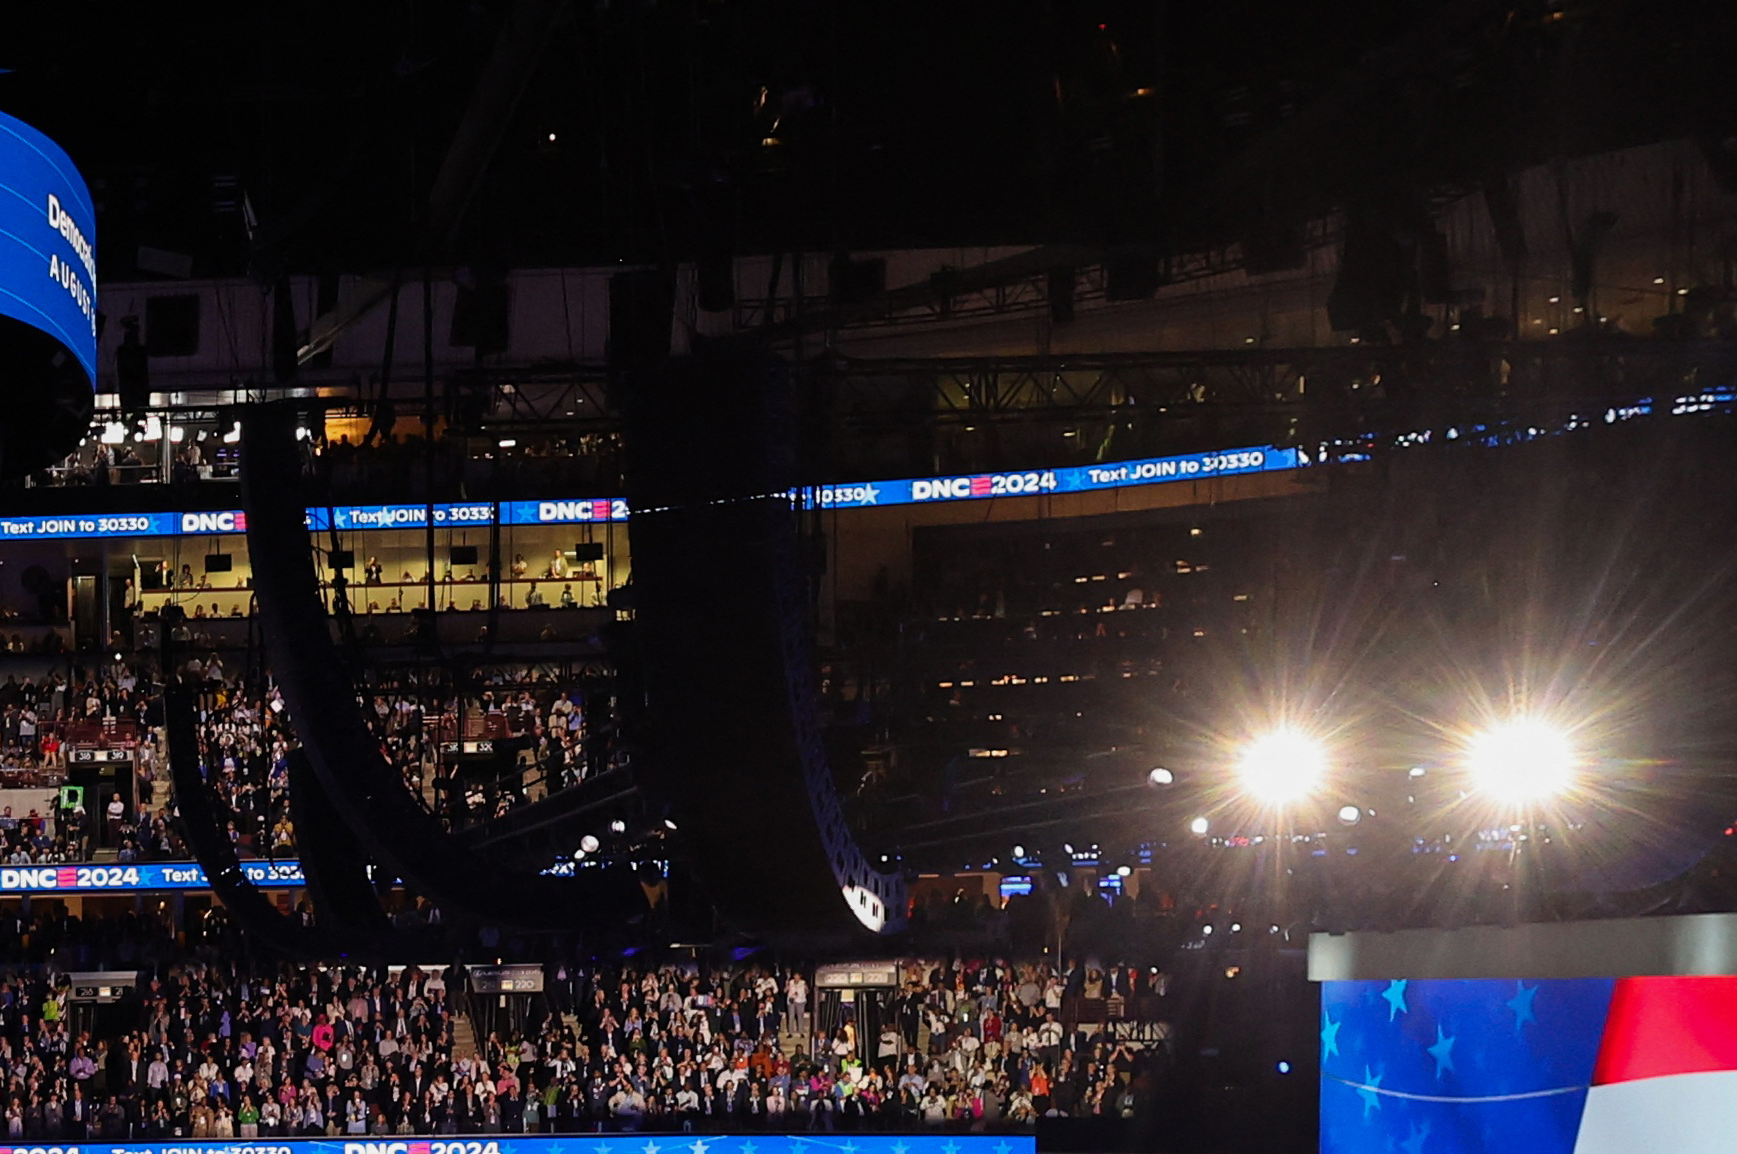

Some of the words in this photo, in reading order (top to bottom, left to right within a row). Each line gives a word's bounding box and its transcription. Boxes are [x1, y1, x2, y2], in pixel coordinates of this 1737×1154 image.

[990, 471, 1057, 494] 2024
[1088, 467, 1128, 484] Text
[1130, 461, 1176, 480] JOIN
[1179, 459, 1200, 475] to
[0, 520, 34, 535] Text
[36, 519, 76, 534] JOIN
[78, 519, 95, 533] to
[98, 517, 149, 533] 30330
[349, 510, 381, 525] Text
[385, 508, 426, 524] JOIN
[76, 866, 140, 888] 2024
[161, 868, 199, 882] Text
